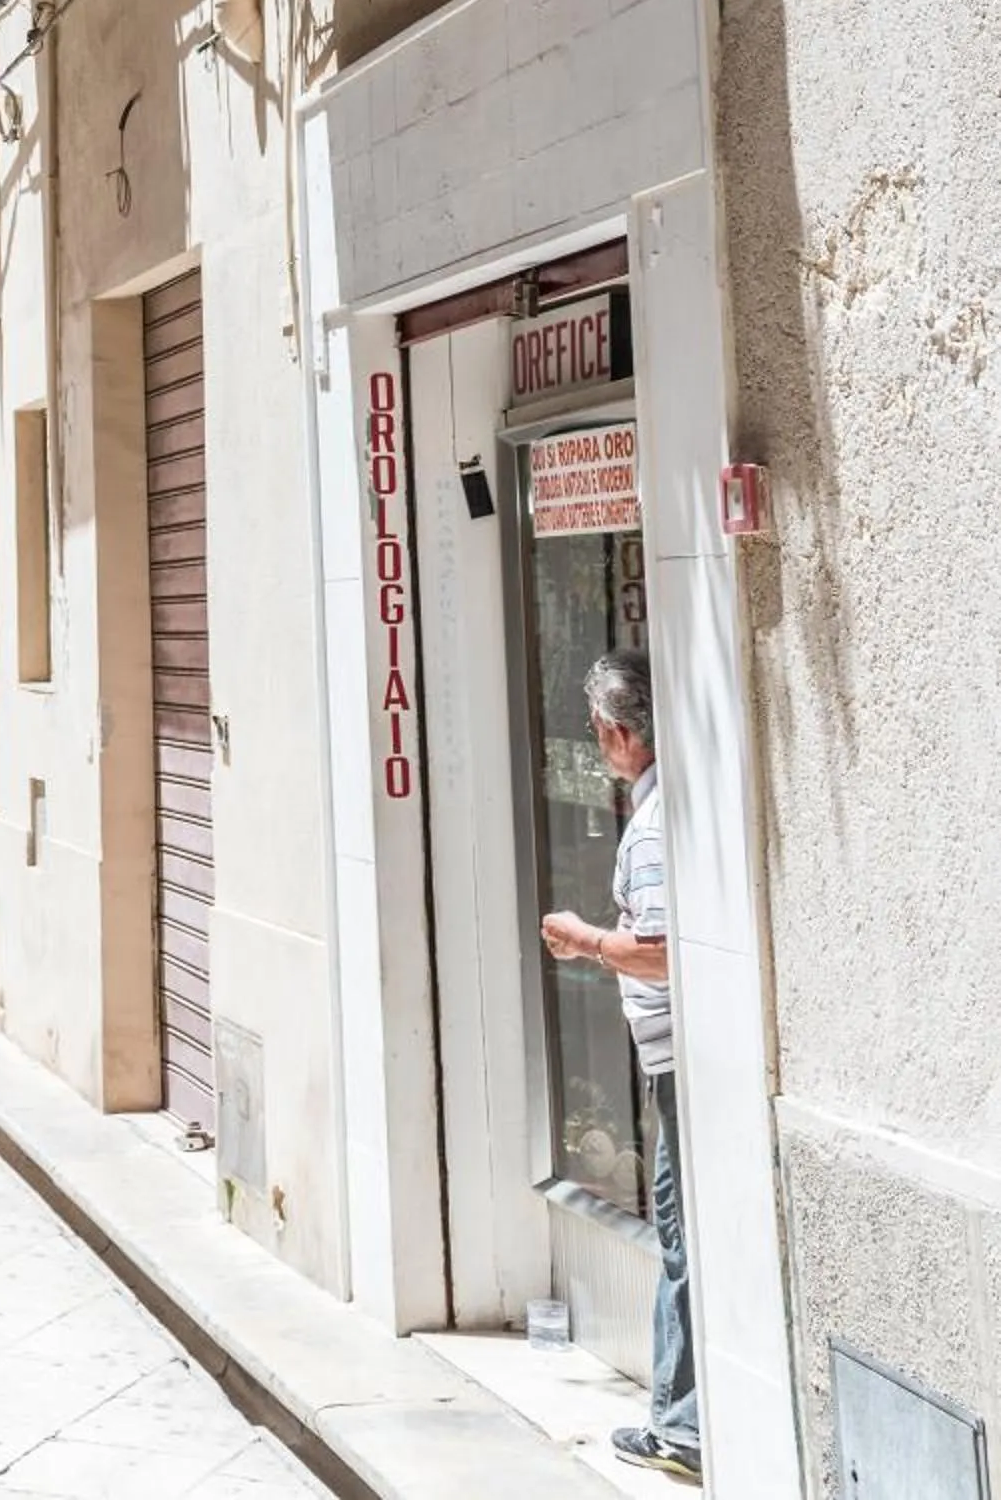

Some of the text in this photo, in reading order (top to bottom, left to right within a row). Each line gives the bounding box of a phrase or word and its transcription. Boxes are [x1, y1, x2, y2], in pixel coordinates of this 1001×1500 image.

[512, 308, 611, 396] OREFICE
[557, 435, 602, 466] RIPARA
[604, 430, 634, 460] ORO
[369, 372, 411, 799] OROLOGIAIO
